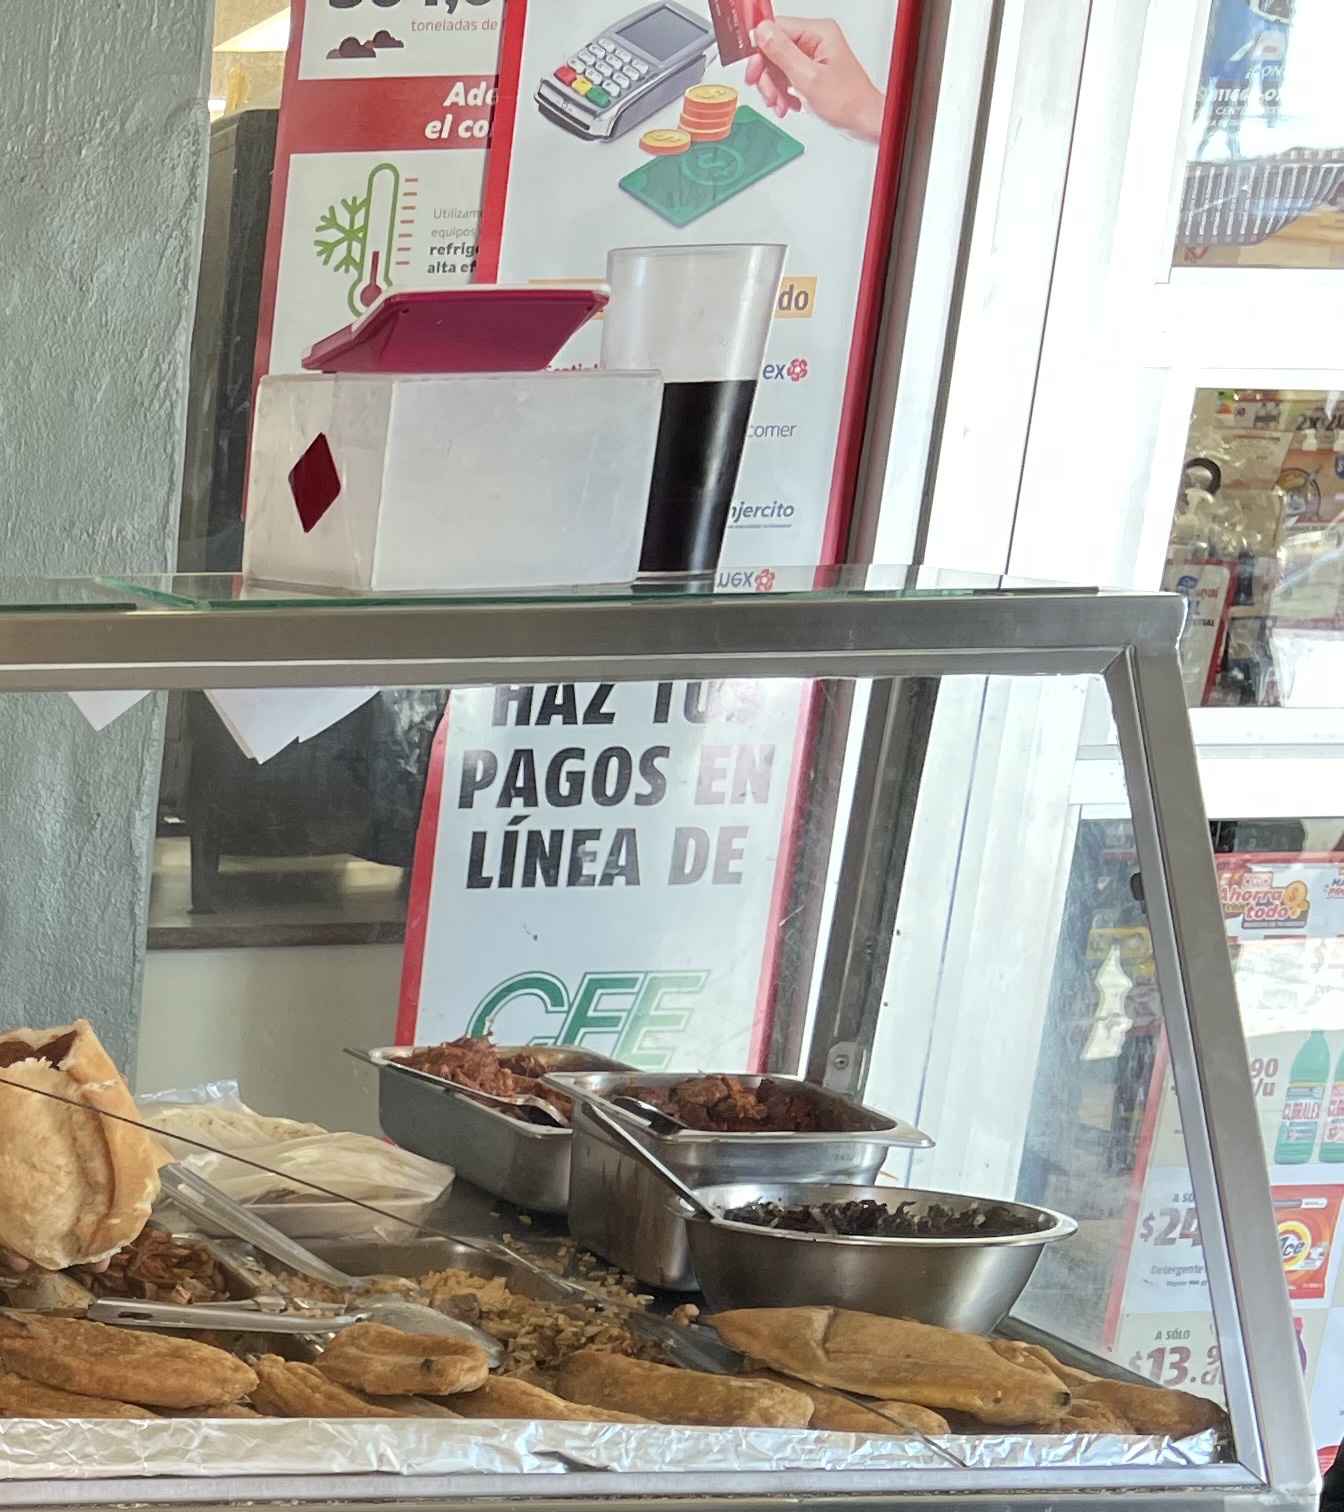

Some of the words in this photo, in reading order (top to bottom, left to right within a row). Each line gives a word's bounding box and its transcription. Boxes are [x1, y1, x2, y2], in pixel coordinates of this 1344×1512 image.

[411, 18, 477, 32] toneladas
[481, 17, 498, 31] de
[424, 114, 453, 139] el
[458, 122, 491, 138] co
[427, 261, 456, 274] alta
[490, 682, 617, 727] HAZ
[457, 744, 671, 810] PAGOS
[693, 743, 777, 806] EN
[465, 814, 642, 890] LÍNEA
[667, 824, 750, 887] DE
[1246, 903, 1289, 919] todo
[466, 969, 712, 1070] CFE
